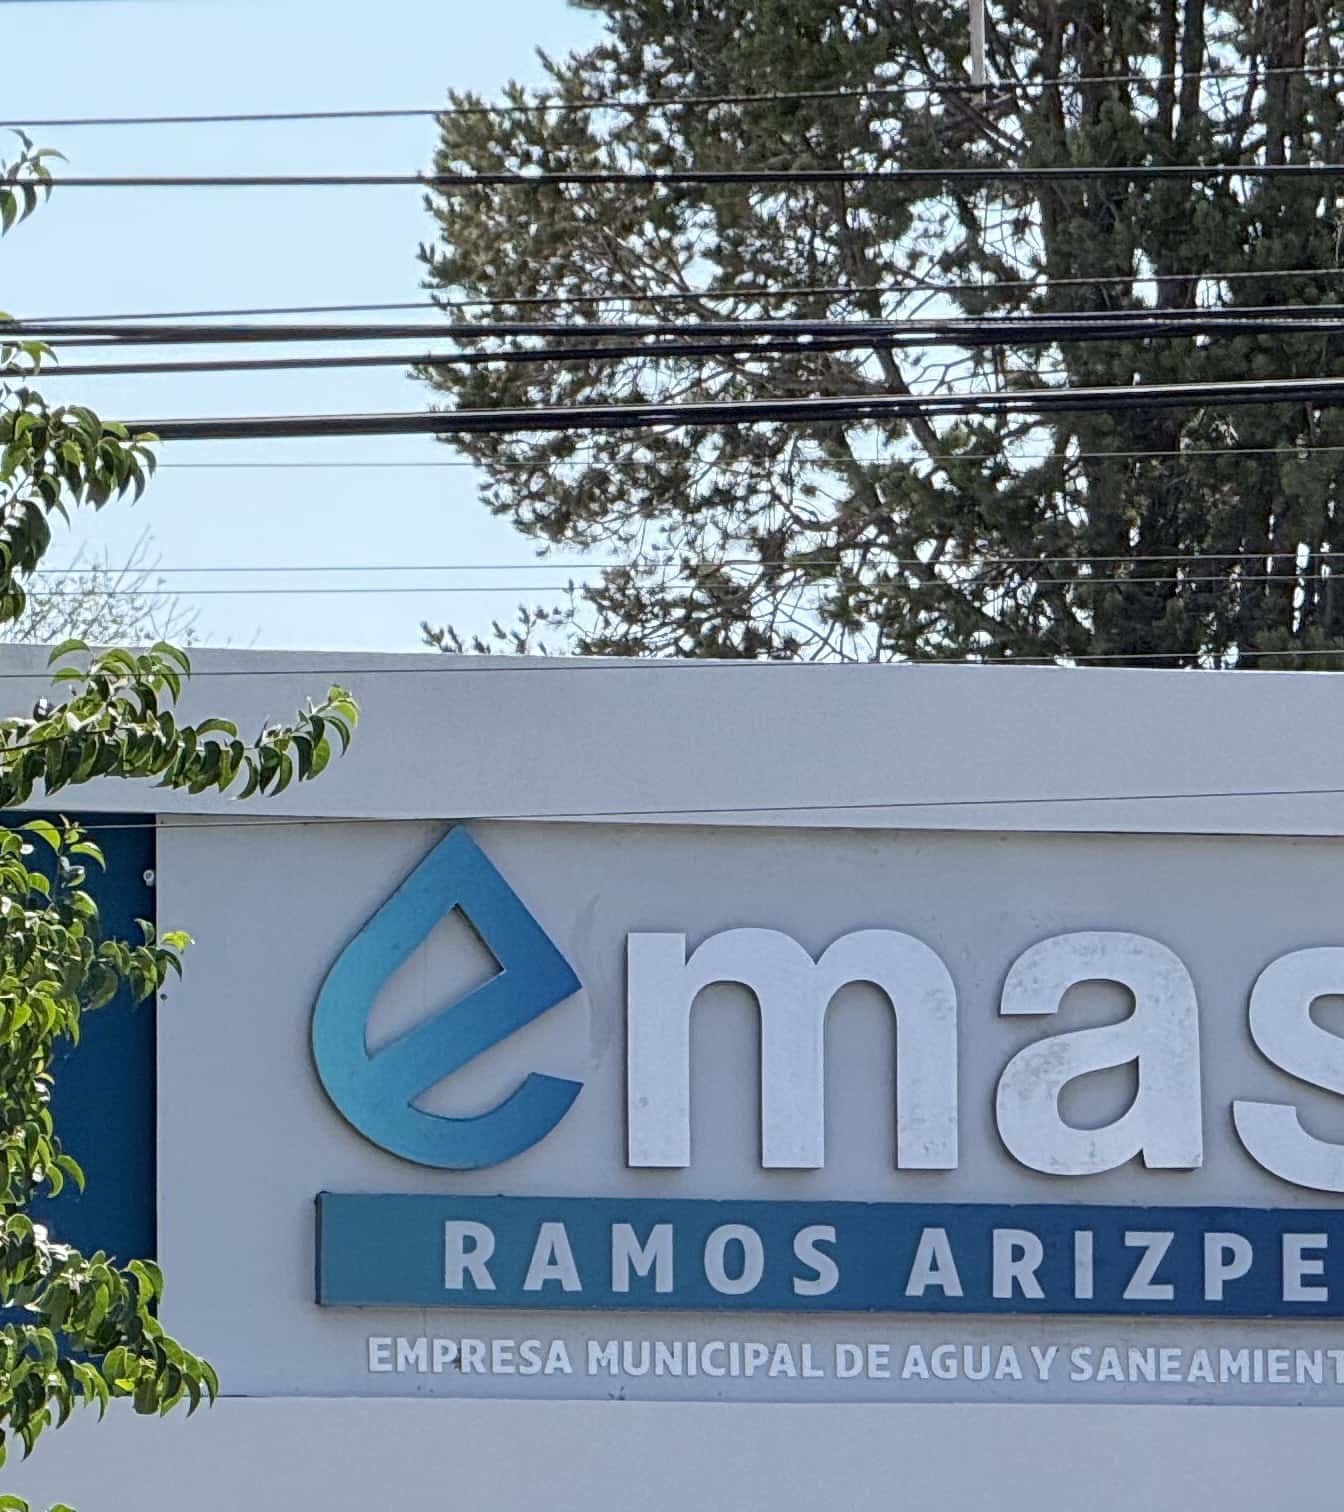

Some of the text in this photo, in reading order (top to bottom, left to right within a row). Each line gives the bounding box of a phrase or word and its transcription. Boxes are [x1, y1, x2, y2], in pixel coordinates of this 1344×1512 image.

[443, 1219, 1332, 1303] RAMOS ARIZPE
[367, 1336, 574, 1375] EMPRESA
[587, 1339, 824, 1379] MUNICIPAL
[835, 1342, 891, 1379] DE
[900, 1344, 1023, 1381] AGUA
[1030, 1346, 1058, 1381] Y
